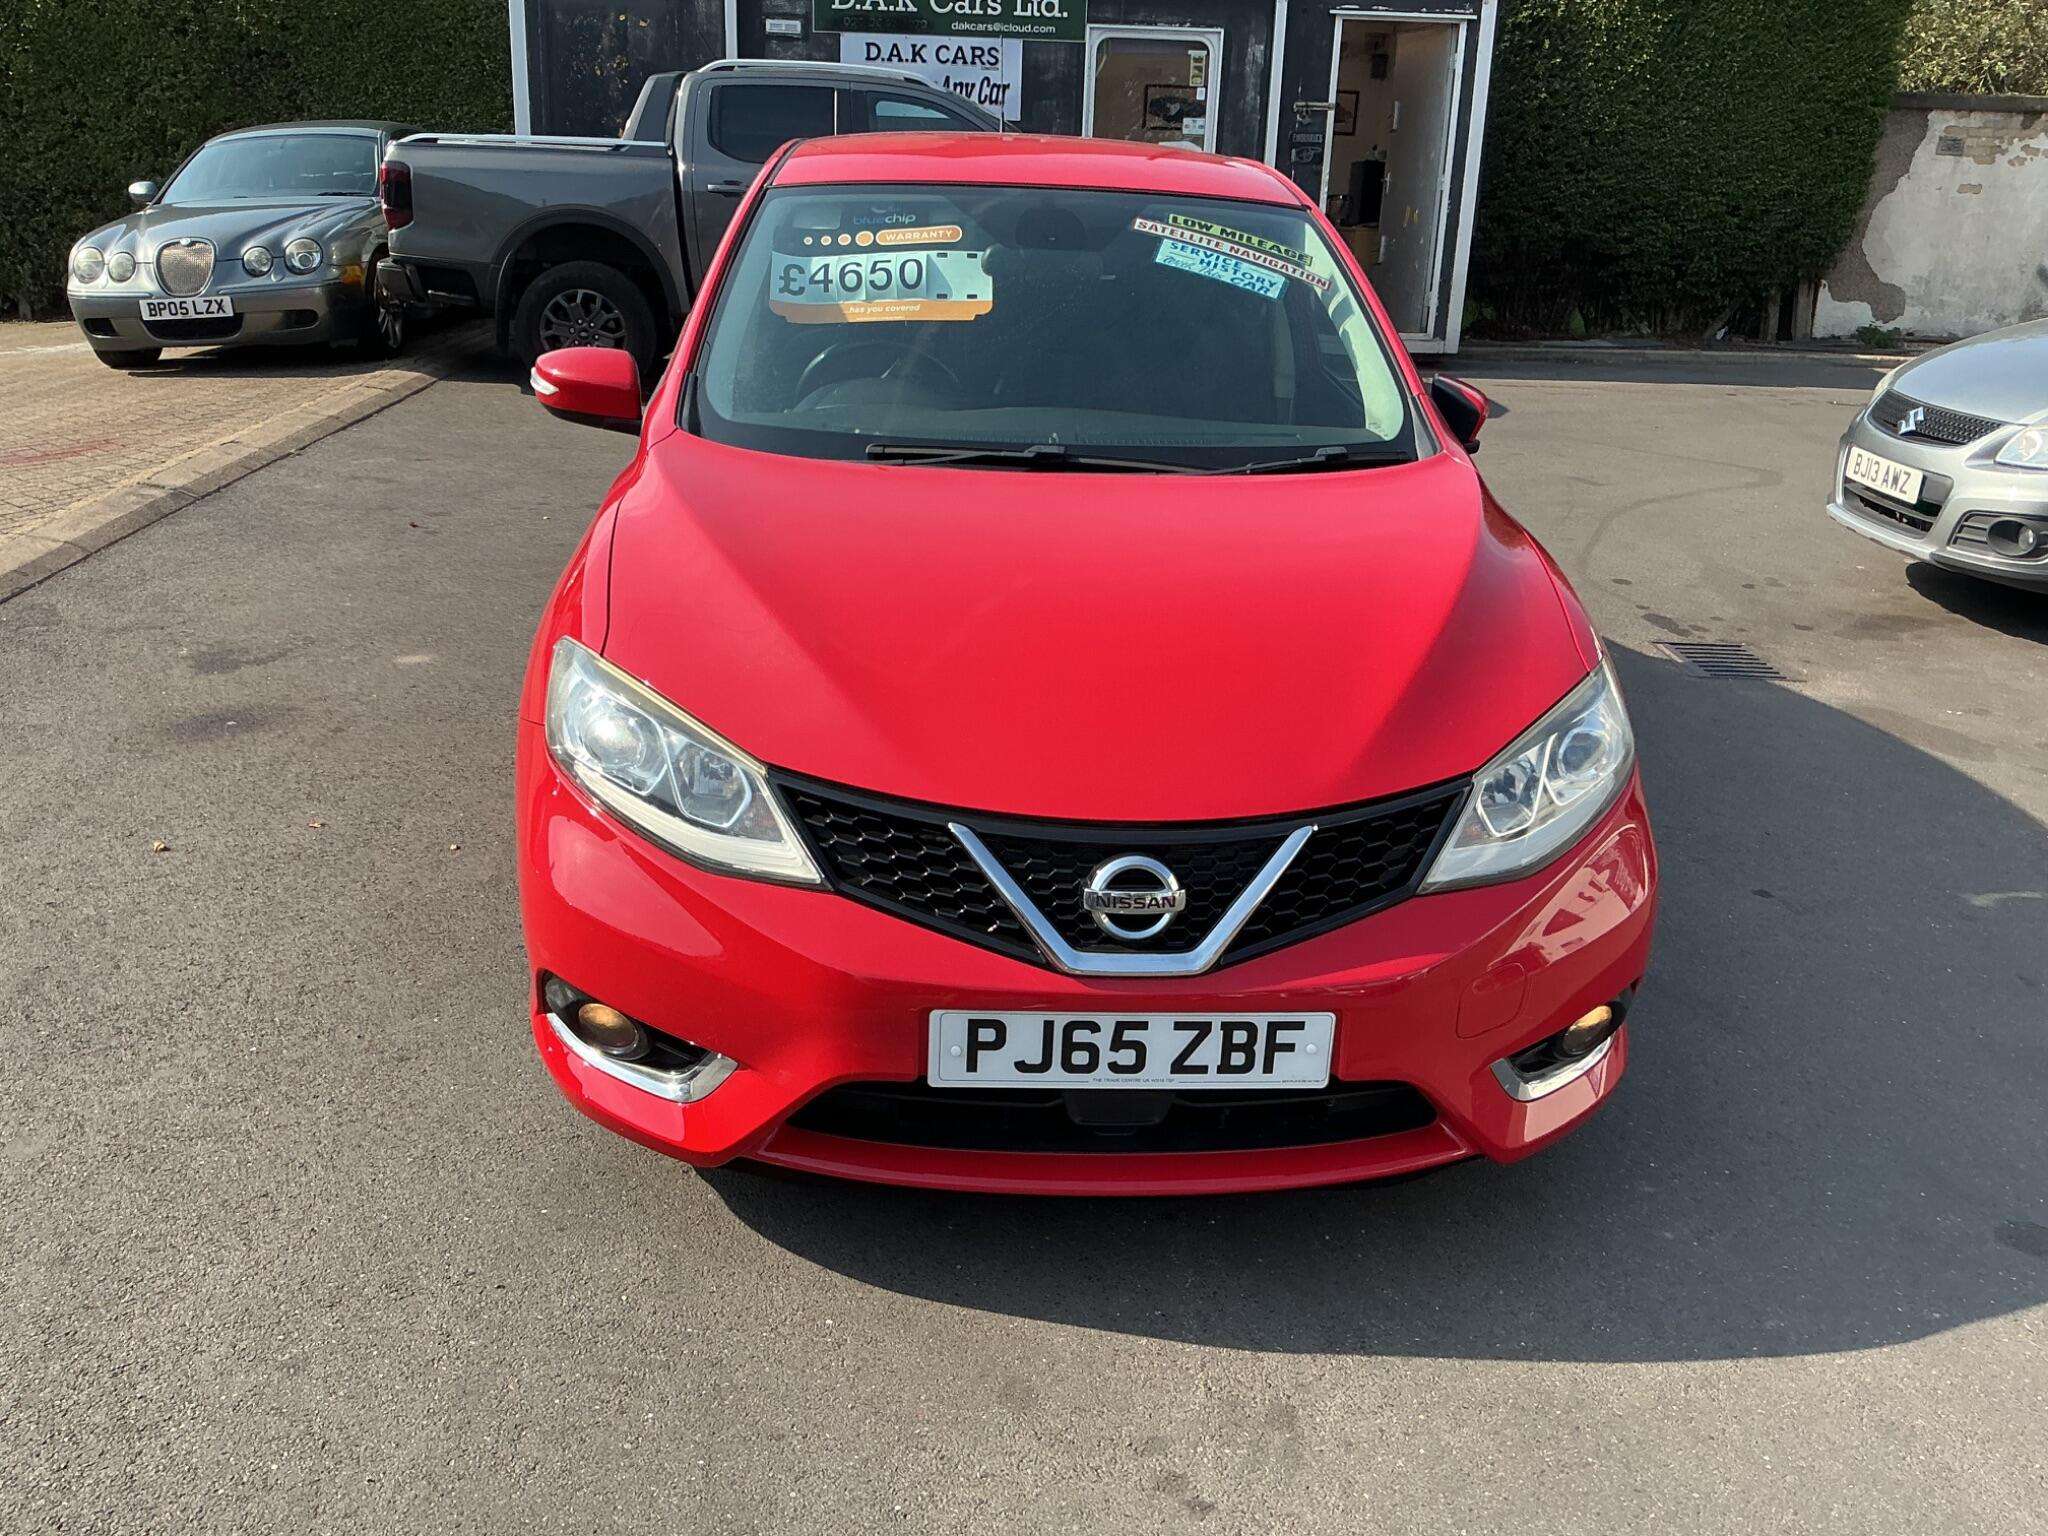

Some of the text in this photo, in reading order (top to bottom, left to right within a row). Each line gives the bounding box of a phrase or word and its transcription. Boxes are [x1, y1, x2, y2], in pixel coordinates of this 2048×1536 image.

[951, 21, 1056, 33] dakcars@icloud.com
[865, 42, 999, 66] D.A.K CARS
[978, 76, 1010, 105] Car
[885, 230, 953, 241] WARRANTY
[1171, 215, 1312, 265] LOW MILEAGE
[1137, 220, 1225, 251] SATELLITE
[1228, 244, 1328, 288] NAVIGATION
[1170, 242, 1242, 268] SERVICE
[778, 258, 924, 297] £4650
[1200, 258, 1278, 288] HISTORY
[1230, 277, 1271, 295] CAR
[146, 299, 226, 317] BP05 LZX
[867, 306, 883, 314] you
[885, 304, 921, 313] covered
[1853, 453, 1912, 495] BJ13 AWZ
[1096, 894, 1176, 909] NISSAN
[965, 1018, 1306, 1075] PJ65 ZBF
